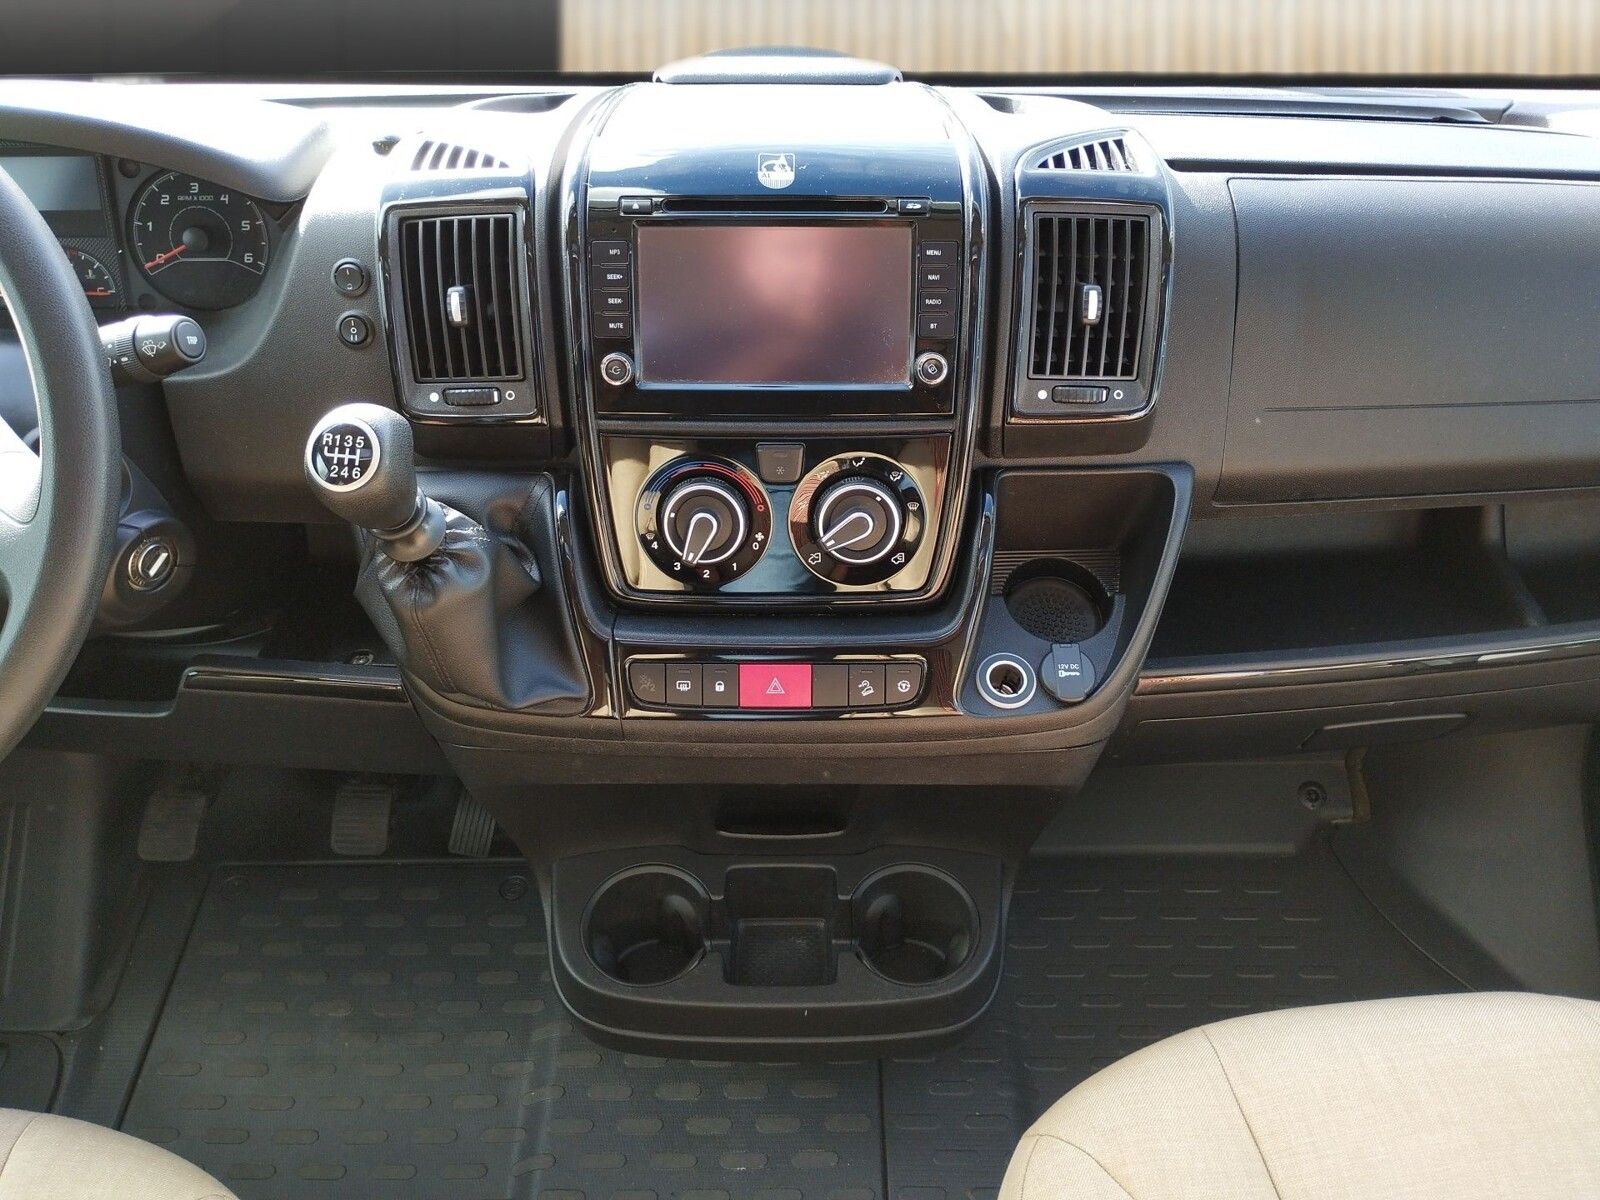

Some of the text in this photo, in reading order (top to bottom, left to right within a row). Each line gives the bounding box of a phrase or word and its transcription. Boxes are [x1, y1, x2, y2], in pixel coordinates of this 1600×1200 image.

[190, 183, 199, 193] 3
[160, 195, 170, 205] 2
[220, 195, 229, 204] 4
[147, 221, 153, 231] 1
[241, 220, 251, 231] 5
[244, 253, 253, 263] 6
[651, 541, 659, 549] 4
[752, 541, 760, 551] 0
[673, 562, 681, 571] 3
[732, 562, 737, 571] 1
[703, 569, 710, 578] 2
